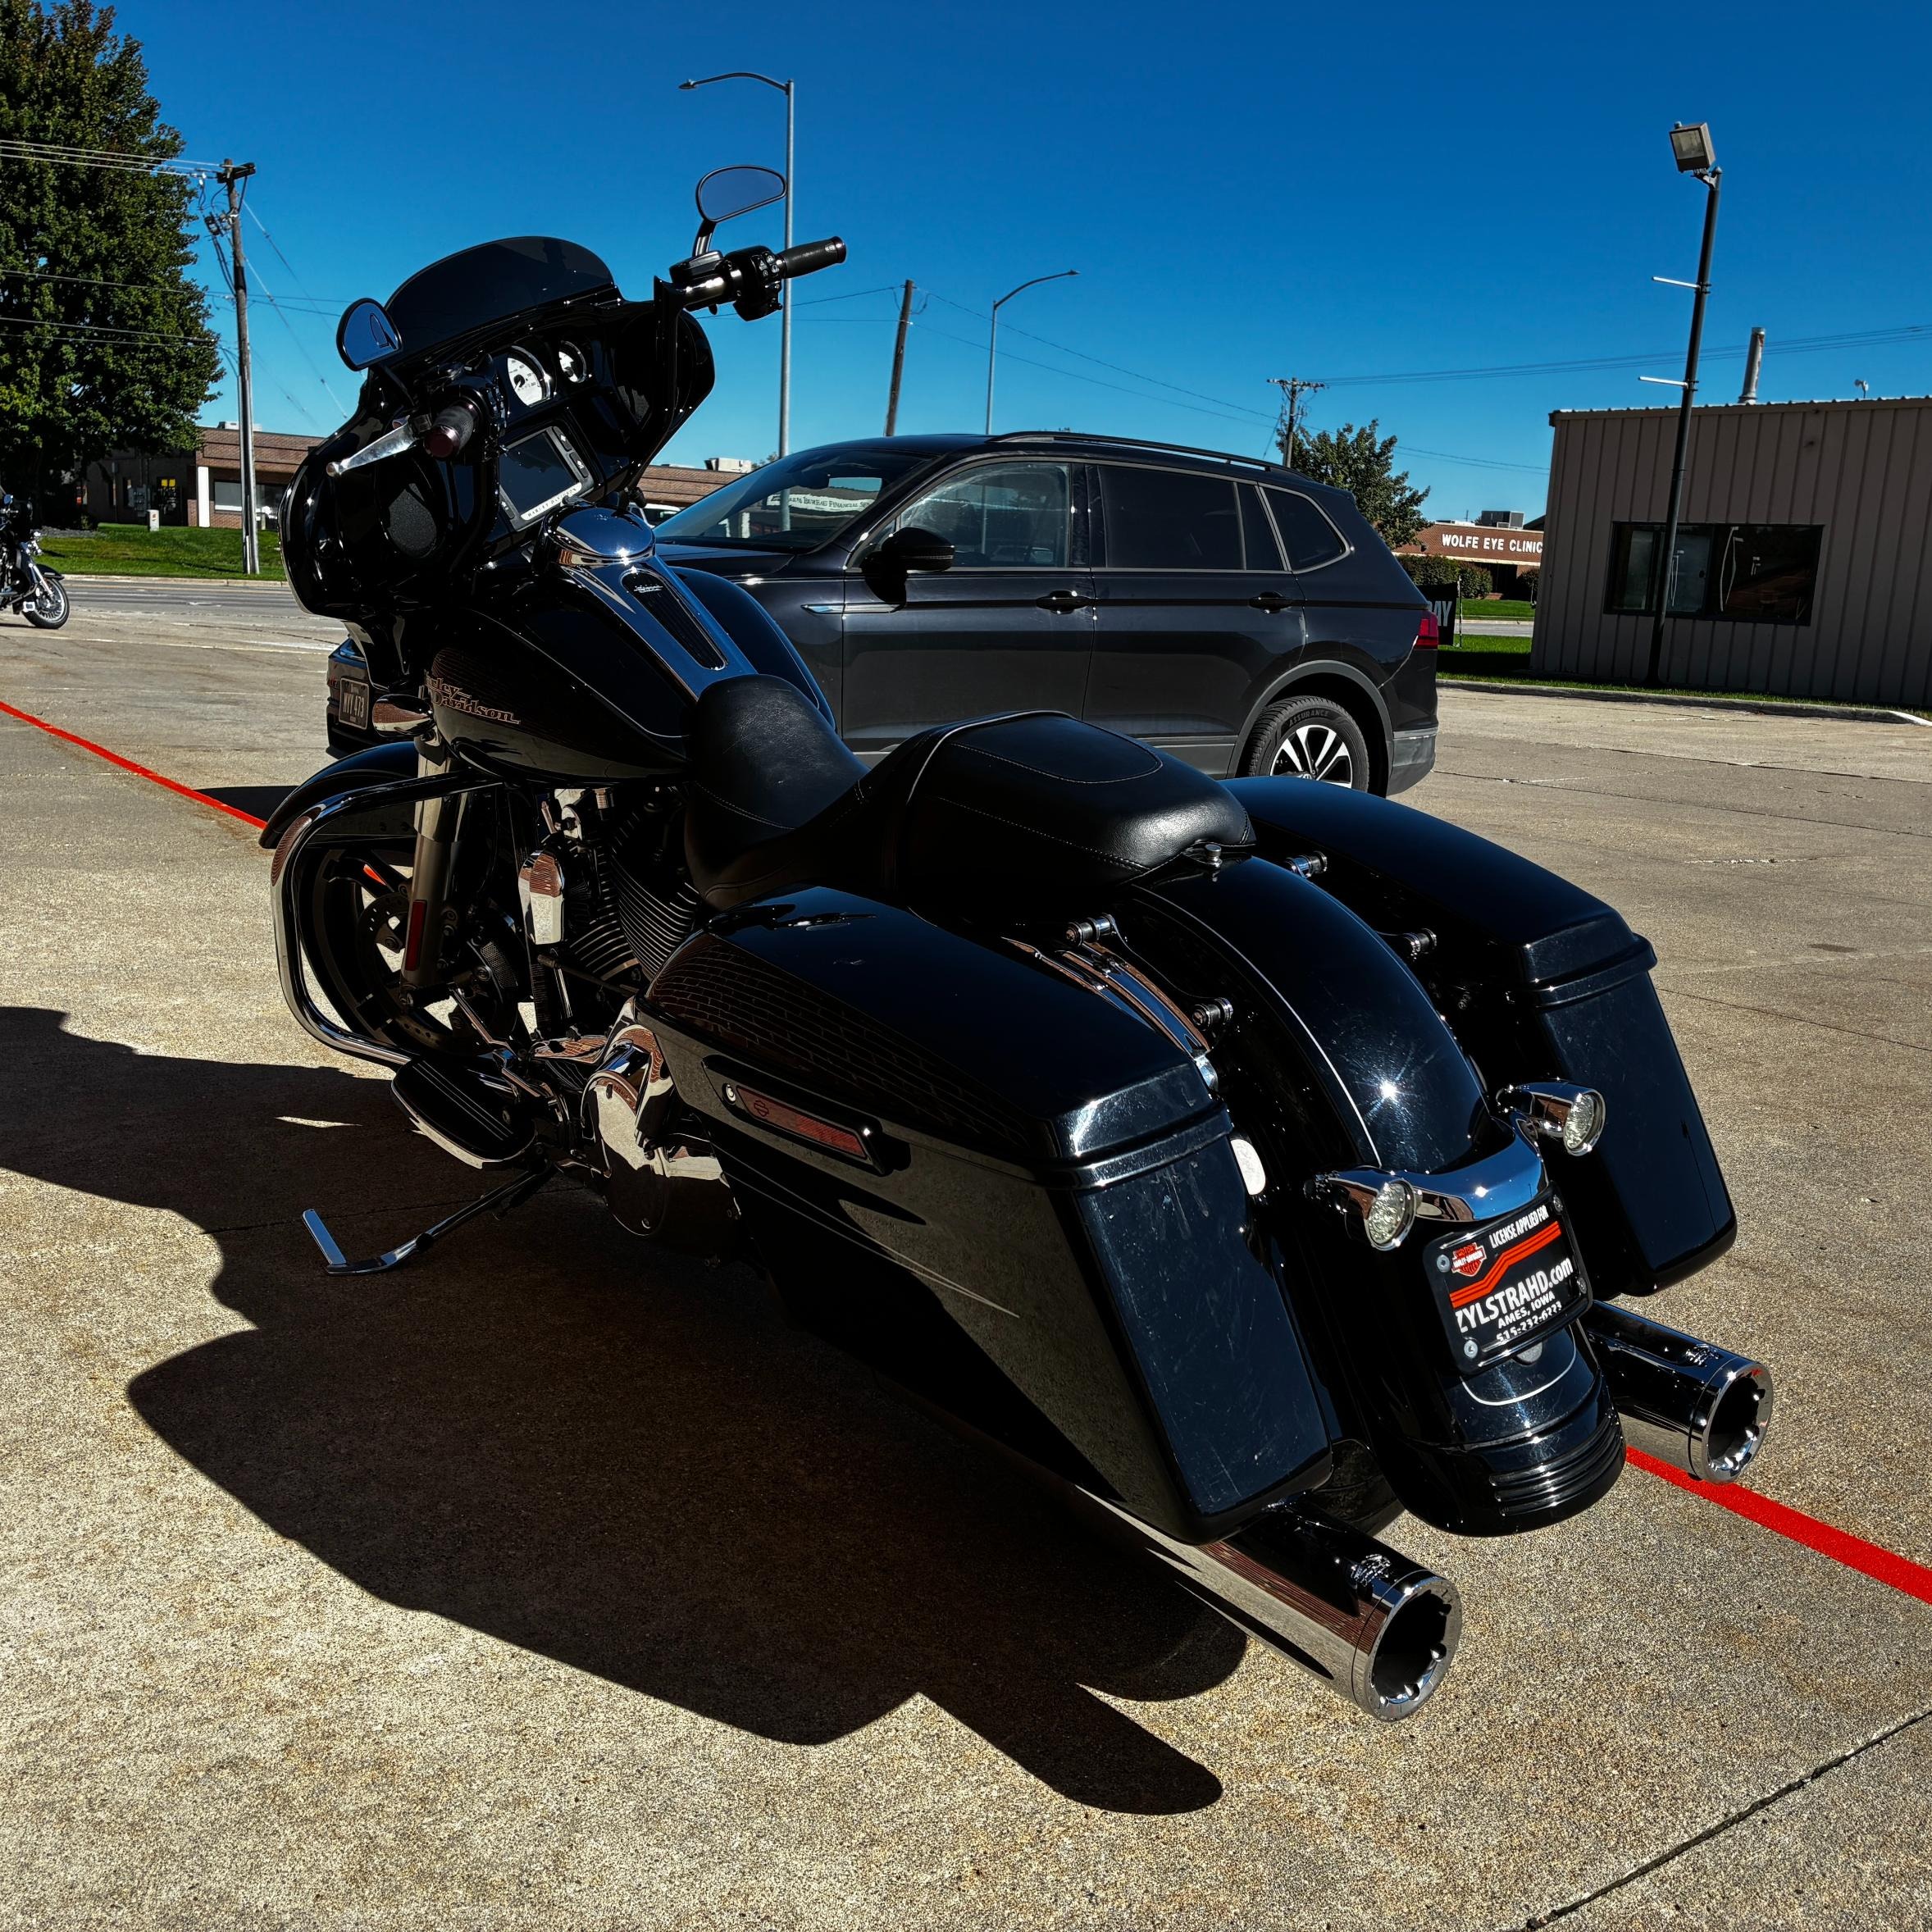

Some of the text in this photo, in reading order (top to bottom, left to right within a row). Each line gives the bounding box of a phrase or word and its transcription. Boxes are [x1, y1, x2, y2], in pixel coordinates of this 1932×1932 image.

[1442, 533, 1543, 554] WOLFE EYE CLINIC
[1428, 600, 1452, 627] AY
[1288, 709, 1330, 727] ASSURANCE
[1488, 1205, 1549, 1249] LICENSE APPLIED FOR
[1455, 1257, 1574, 1333] ZYLSTRAHD.com
[1497, 1291, 1556, 1329] AMES, IOWA
